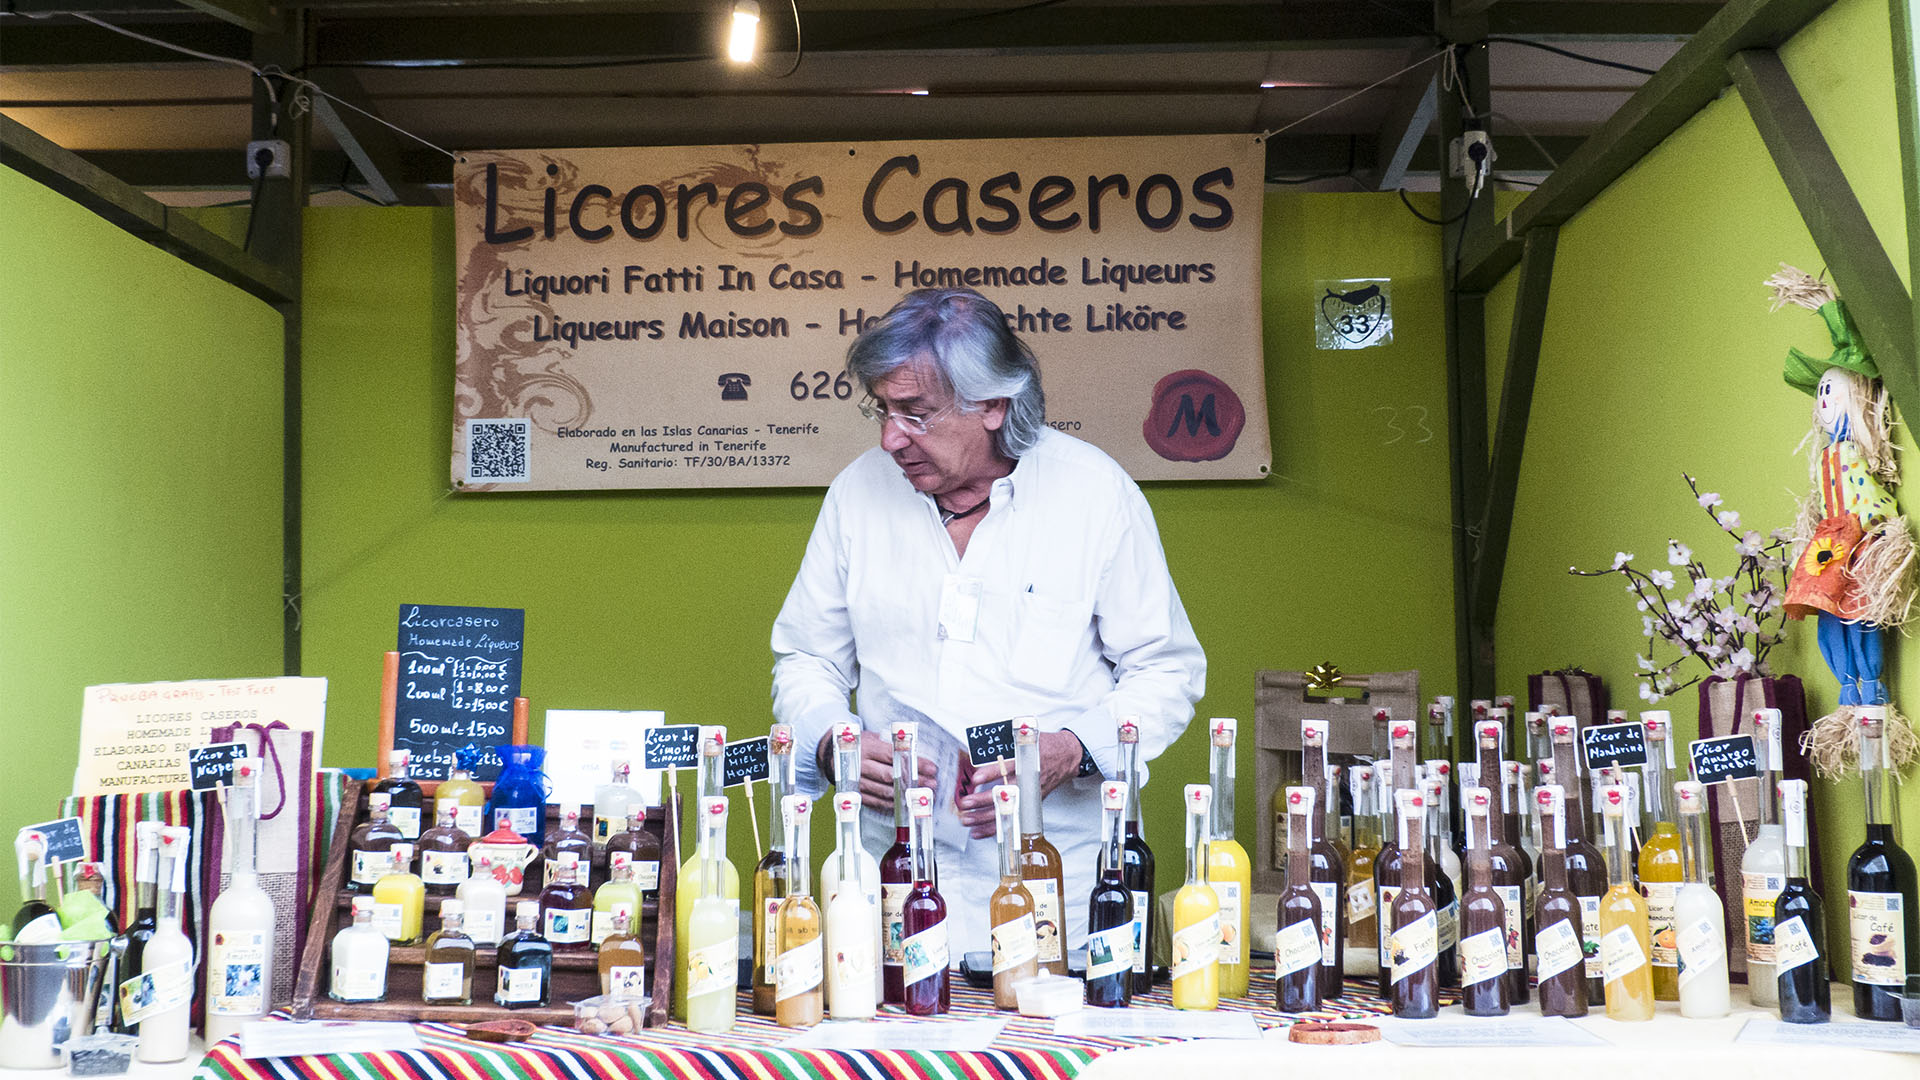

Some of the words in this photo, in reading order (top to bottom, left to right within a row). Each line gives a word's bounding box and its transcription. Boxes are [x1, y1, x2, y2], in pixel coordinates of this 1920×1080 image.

[484, 163, 824, 245] Licores
[862, 154, 1235, 237] Caseros
[505, 266, 610, 303] Liquori
[624, 264, 705, 296] Fatti
[718, 264, 756, 292] In
[768, 263, 844, 291] Casa
[894, 256, 1068, 288] Homemade
[1081, 257, 1216, 292] Liqueurs
[533, 313, 665, 349] Liqueurs
[679, 311, 789, 340] Maison
[1086, 303, 1188, 332] Liköre
[1341, 314, 1370, 334] 33
[557, 427, 617, 439] Elaborado
[622, 429, 636, 438] en
[641, 426, 657, 438] las
[663, 426, 692, 437] Islas
[697, 425, 749, 437] Canarias
[767, 423, 819, 436] Tenerife
[1373, 406, 1433, 444] 33
[610, 441, 693, 453] Manufactured
[700, 441, 709, 451] in
[714, 439, 767, 451] Tenerife
[586, 458, 612, 471] Reg.
[619, 457, 678, 469] Sanitario:
[684, 456, 790, 469] TF/30/BA/13372
[402, 606, 500, 629] Licorcasero
[408, 633, 471, 649] Homemade
[475, 634, 520, 653] Liqueurs
[137, 712, 192, 724] LICORES
[201, 709, 258, 721] CASEROS
[127, 727, 192, 740] HOMEMADE
[645, 728, 678, 745] Licor
[682, 728, 695, 742] de
[987, 734, 1000, 745] de
[1585, 729, 1621, 745] Licor
[1627, 728, 1640, 739] de
[94, 743, 167, 757] ELABORADO
[175, 742, 191, 753] EN
[190, 748, 223, 763] Licor
[230, 746, 244, 758] de
[409, 748, 452, 765] rueba
[725, 744, 754, 758] icor
[1693, 742, 1730, 758] Licor
[117, 758, 181, 771] CANARIAS
[728, 756, 757, 767] MIEL
[726, 763, 766, 779] HONEY
[100, 773, 189, 788] MANUFACTURE
[1870, 922, 1895, 933] Café
[1544, 938, 1578, 961] Chocolate
